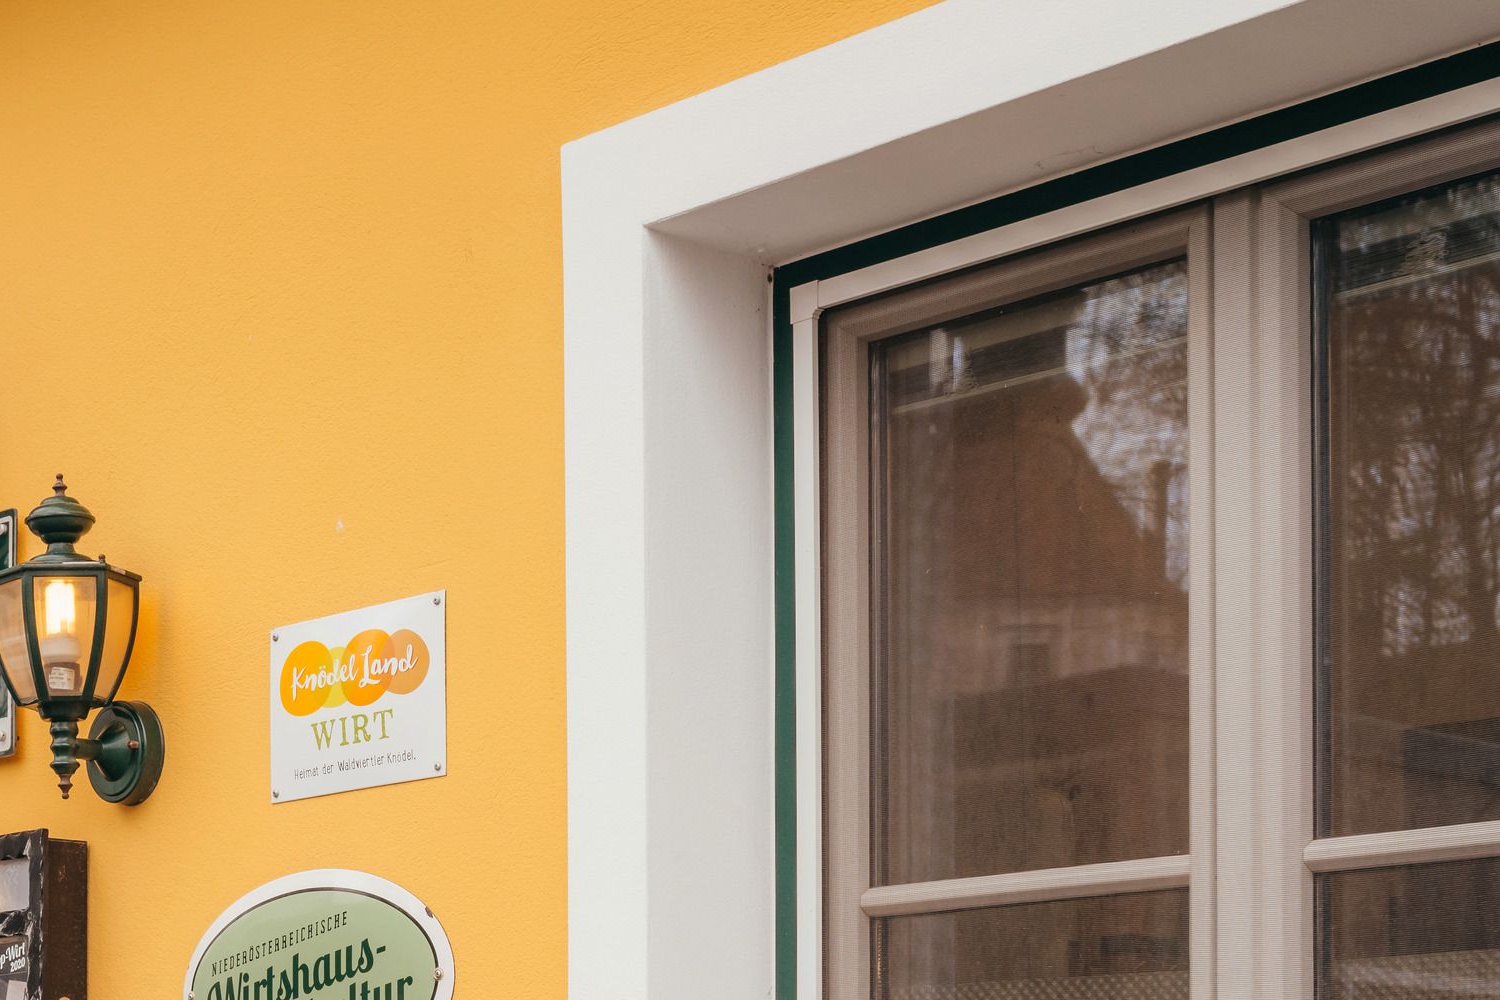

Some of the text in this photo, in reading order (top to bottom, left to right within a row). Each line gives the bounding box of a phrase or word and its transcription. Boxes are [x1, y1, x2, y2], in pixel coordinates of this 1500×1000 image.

[291, 644, 419, 702] Knödel Land
[311, 709, 394, 751] WIRT
[294, 765, 319, 780] Heimat
[322, 762, 334, 775] der
[337, 754, 384, 772] Waldviertler
[211, 911, 348, 976] NIEDERÖSTERREICHISCHE
